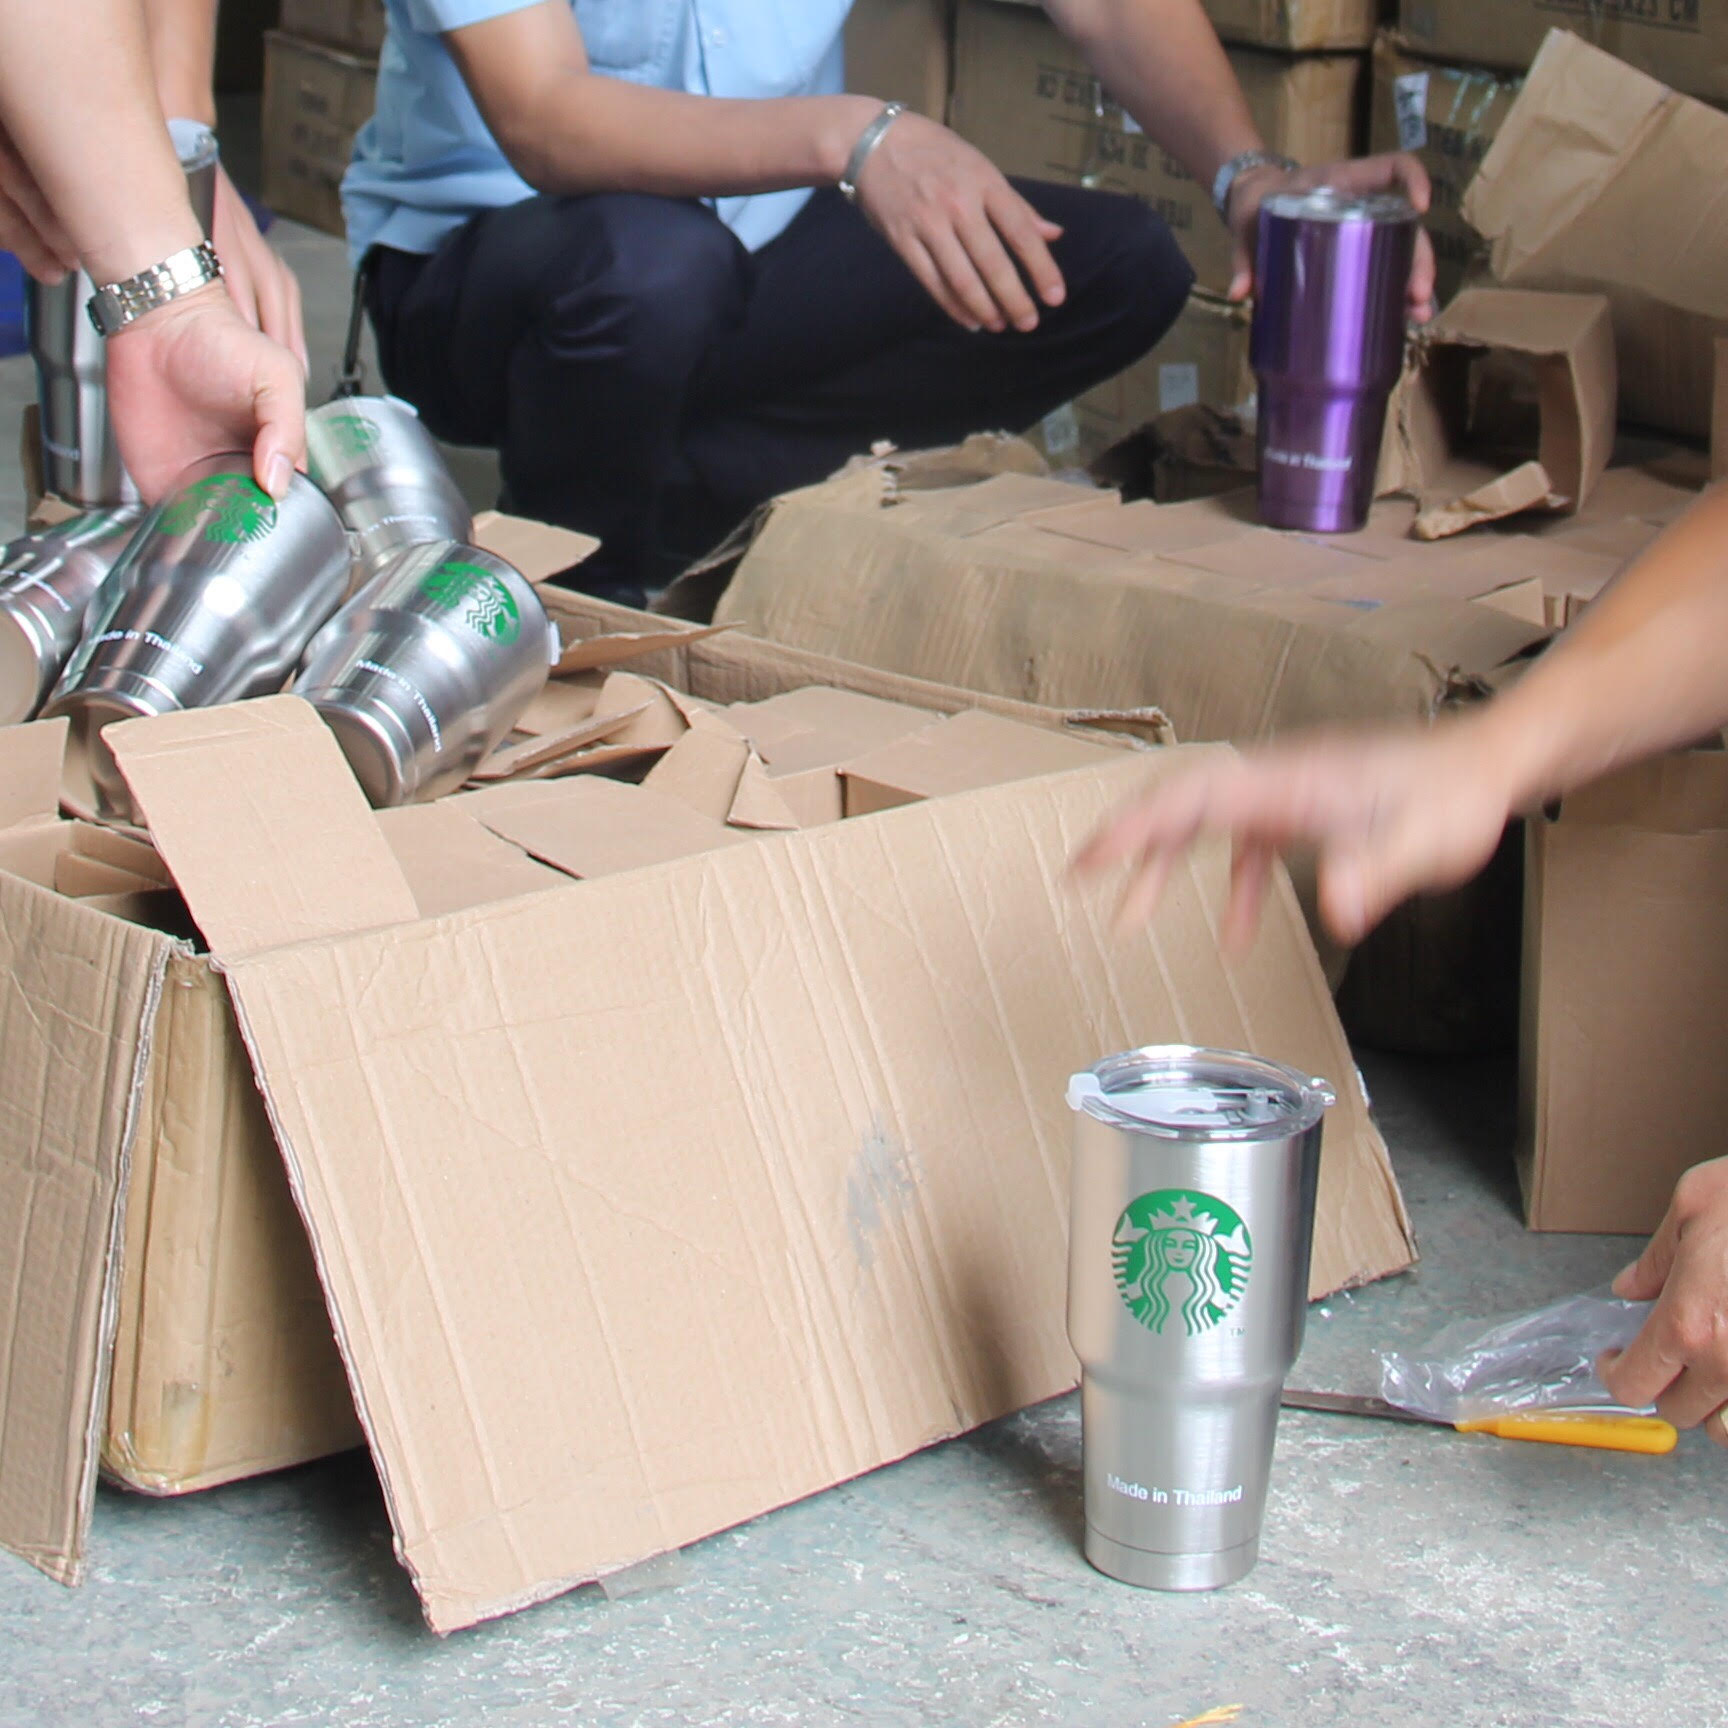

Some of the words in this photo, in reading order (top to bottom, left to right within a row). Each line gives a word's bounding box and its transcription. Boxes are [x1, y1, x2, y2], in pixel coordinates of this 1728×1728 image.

[355, 658, 396, 680] Made
[398, 676, 412, 692] in
[413, 689, 443, 753] Thailand
[1106, 1473, 1148, 1501] Made
[1152, 1486, 1169, 1505] in
[1172, 1484, 1243, 1506] Thailand
